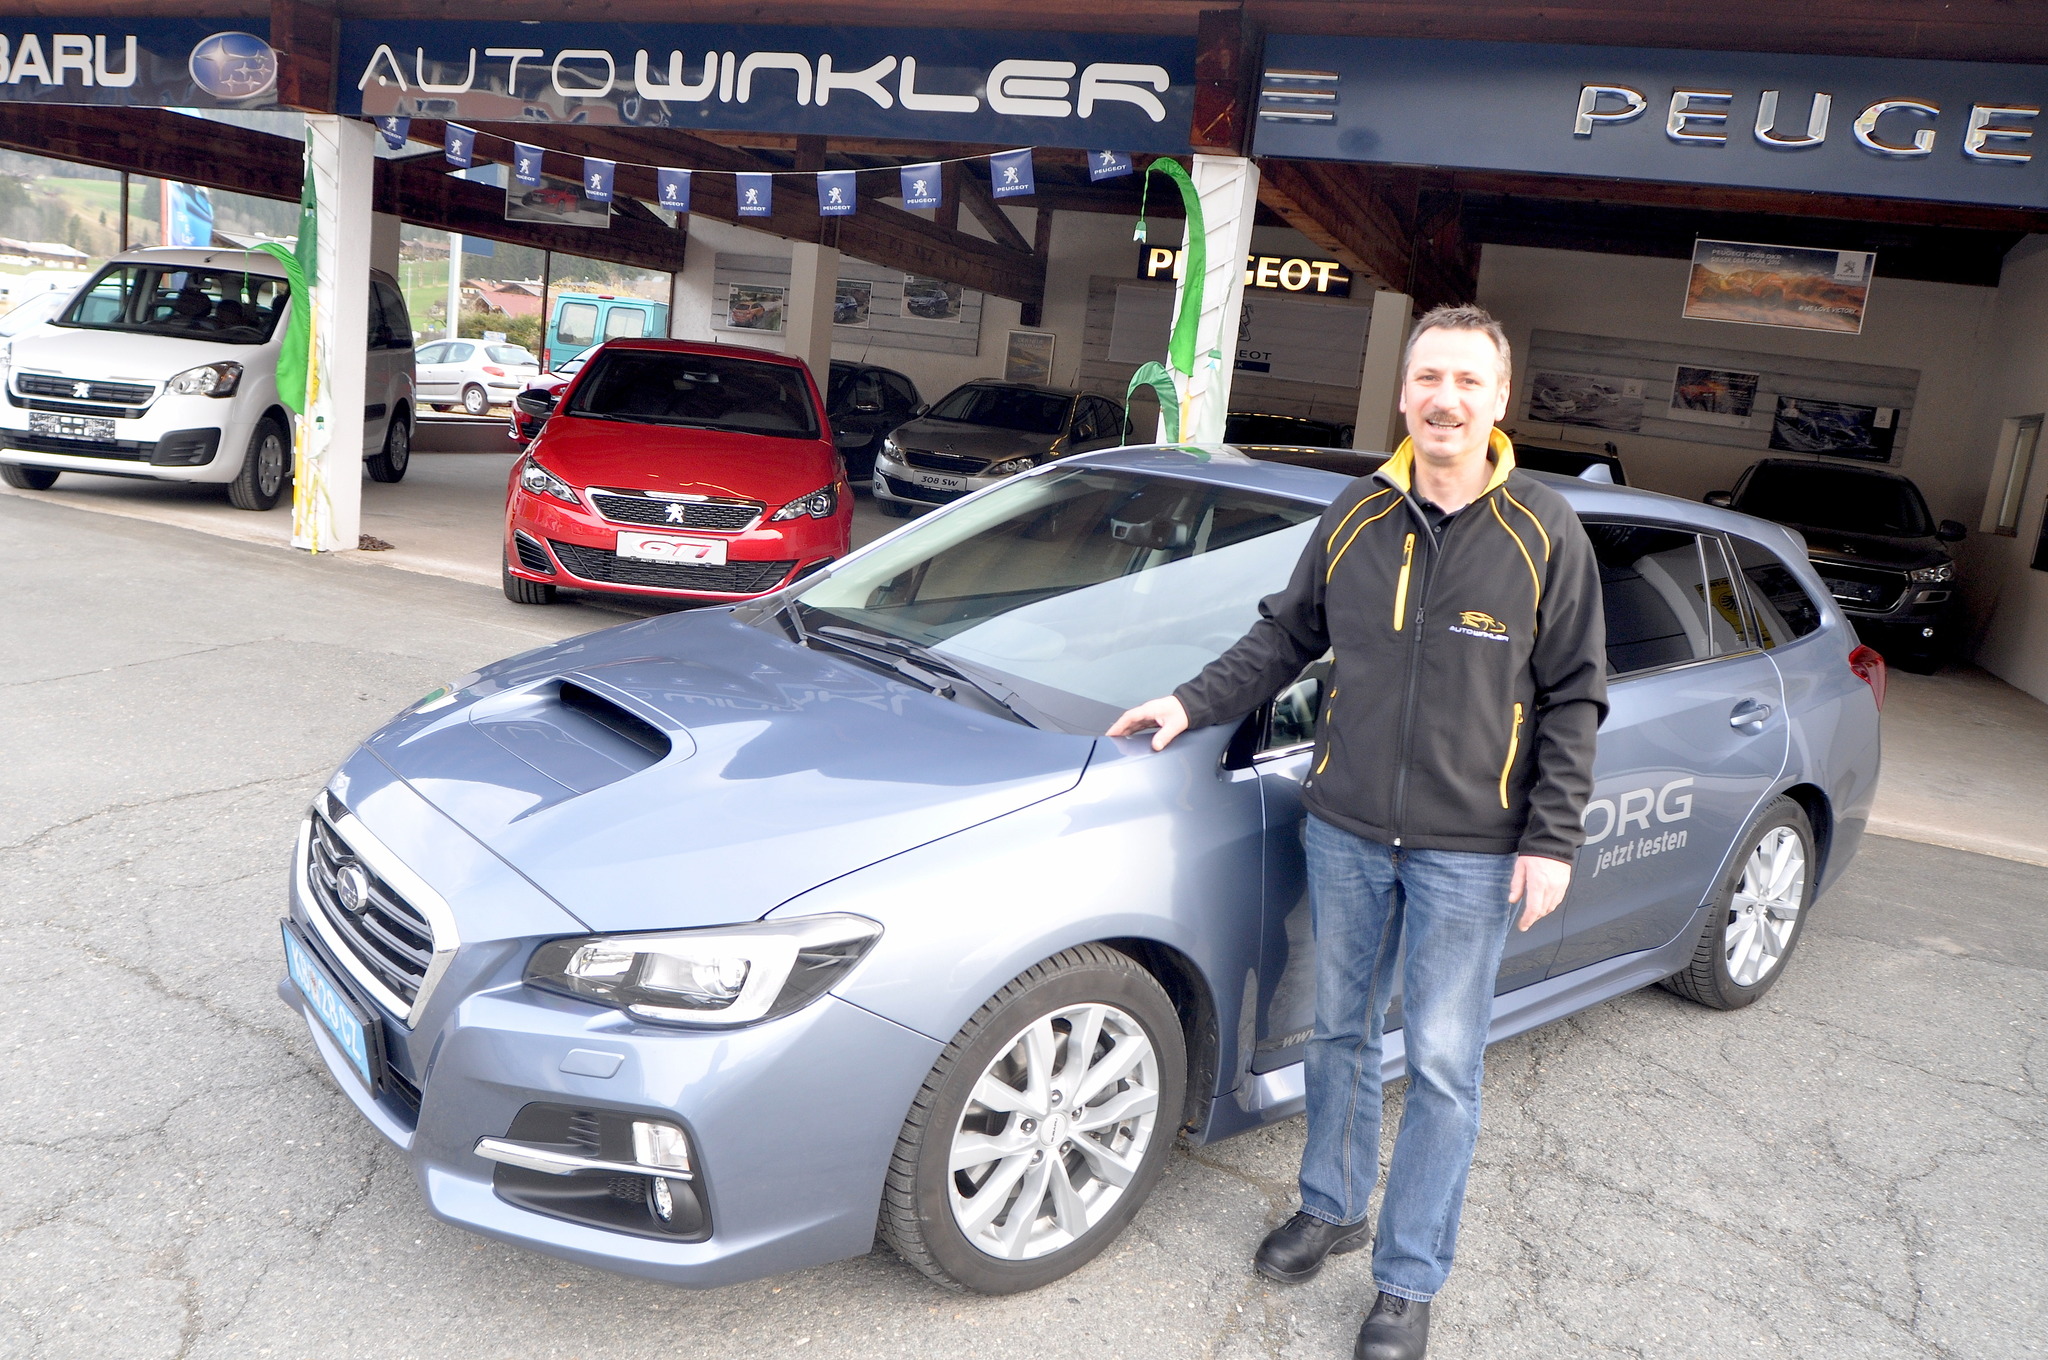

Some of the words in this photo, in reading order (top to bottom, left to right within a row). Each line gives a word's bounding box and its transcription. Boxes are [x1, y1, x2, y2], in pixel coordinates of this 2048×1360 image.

[0, 33, 137, 88] ARU
[1094, 165, 1127, 175] PEUGEOT
[997, 184, 1029, 192] PEUGEOT
[1711, 249, 1746, 258] PEUGEOT
[920, 475, 940, 485] 308
[941, 478, 959, 487] SW
[1592, 840, 1635, 879] jetzt
[1636, 829, 1688, 859] testen
